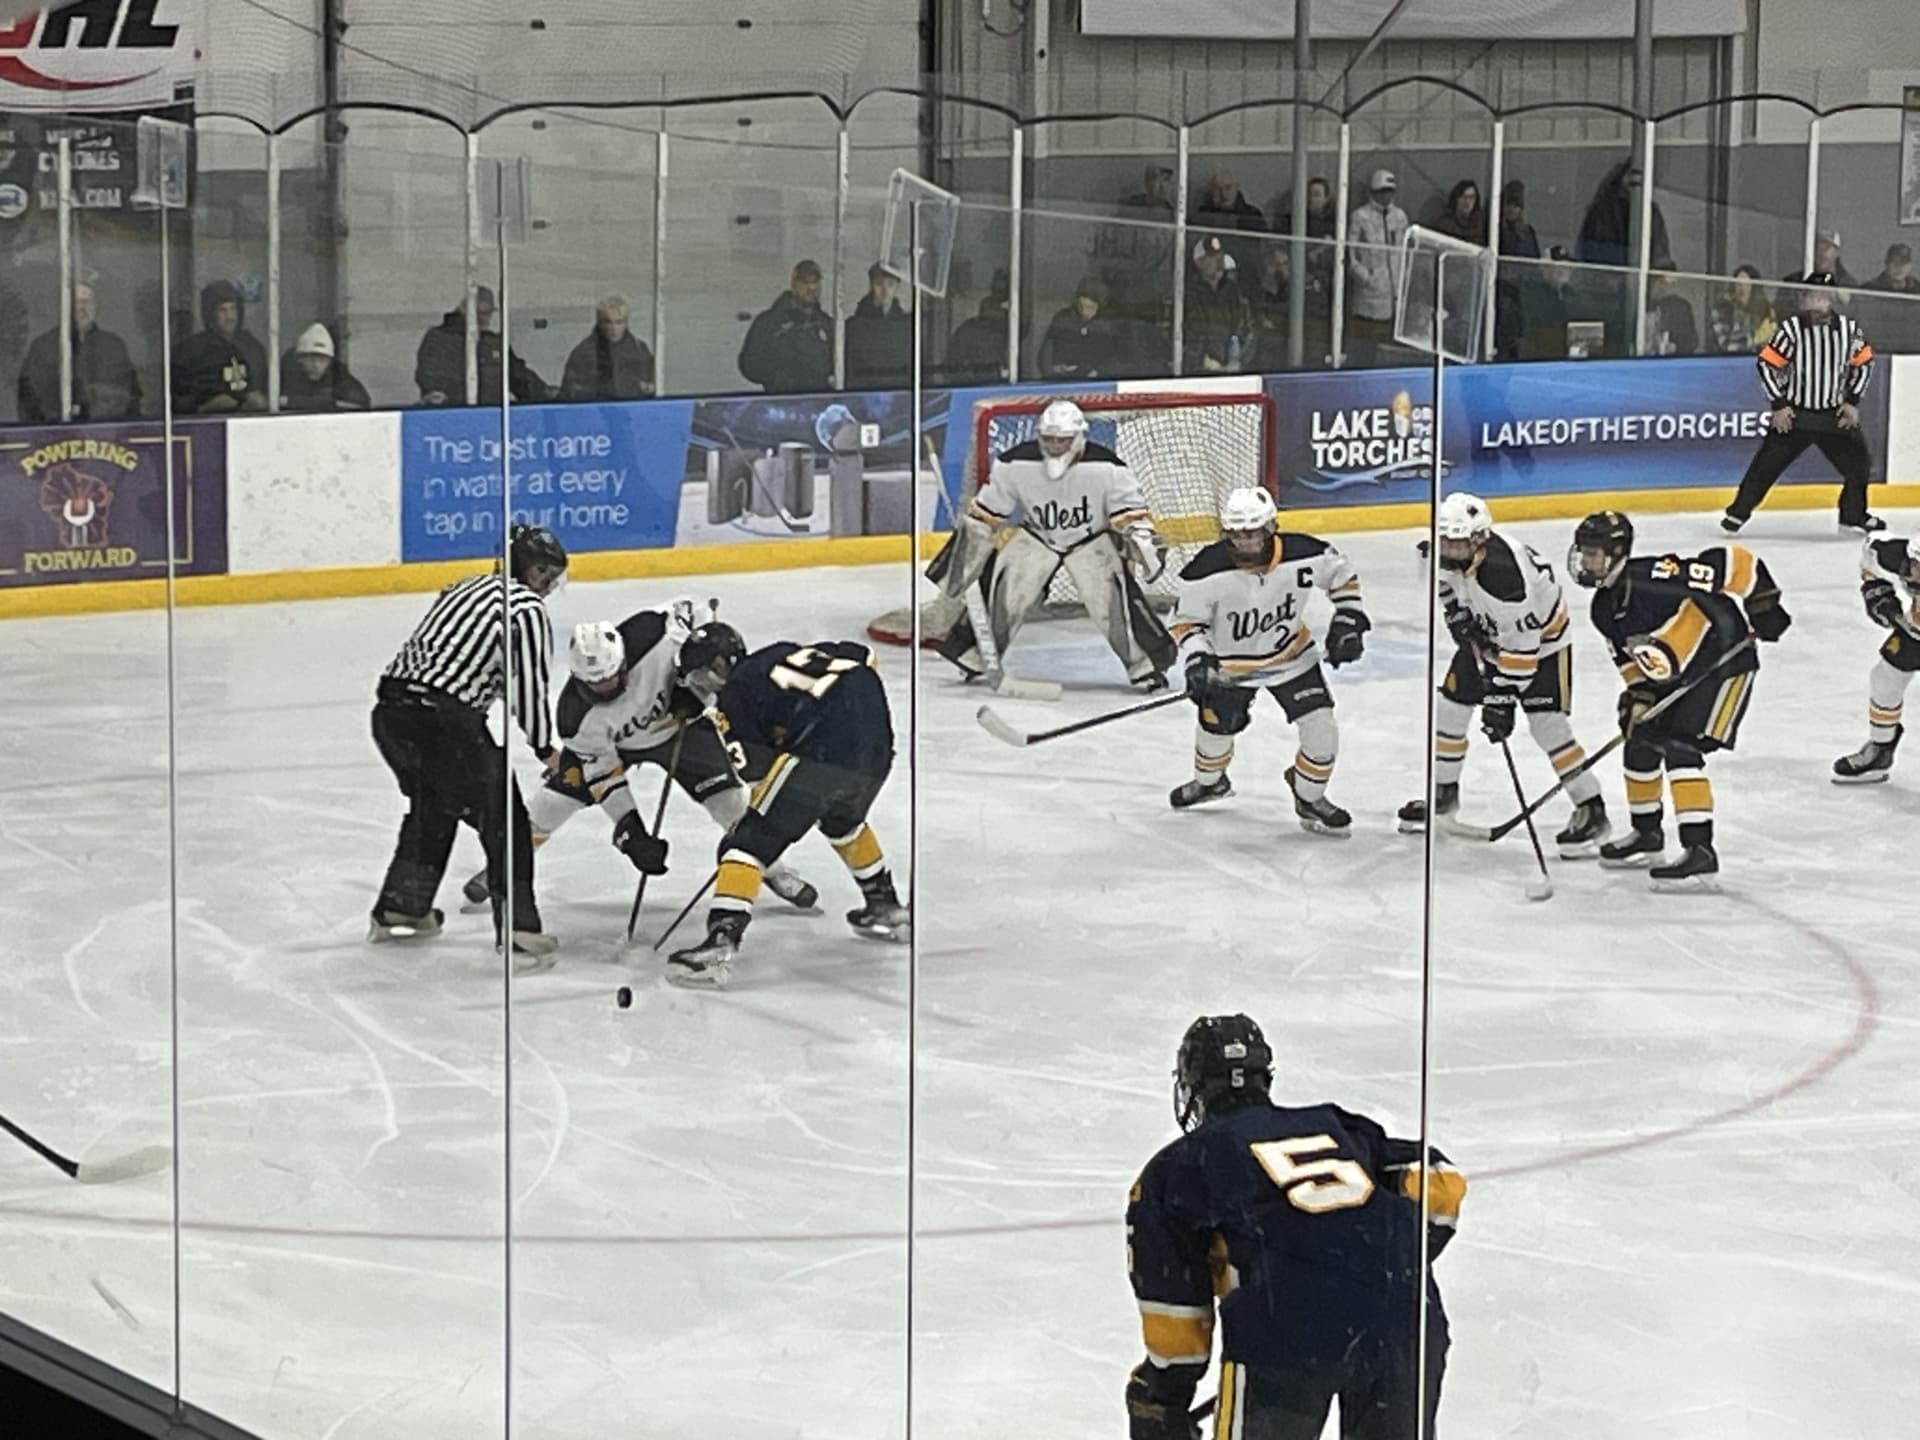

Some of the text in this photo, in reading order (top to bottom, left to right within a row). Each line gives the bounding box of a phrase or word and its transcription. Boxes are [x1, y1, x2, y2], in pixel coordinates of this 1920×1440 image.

[1312, 408, 1390, 440] LAKE
[20, 440, 139, 476] POWERING
[423, 435, 474, 463] The
[542, 434, 612, 459] name
[423, 474, 446, 499] in
[528, 468, 554, 495] at
[559, 467, 630, 497] every
[423, 510, 467, 541] tap
[472, 510, 495, 532] in
[559, 501, 630, 528] home
[1031, 495, 1093, 531] West
[24, 547, 137, 573] FORWARD
[1297, 566, 1313, 588] C
[1226, 592, 1297, 642] West
[1274, 624, 1290, 650] 2
[1231, 1067, 1245, 1088] 5
[1249, 1132, 1376, 1214] 5
